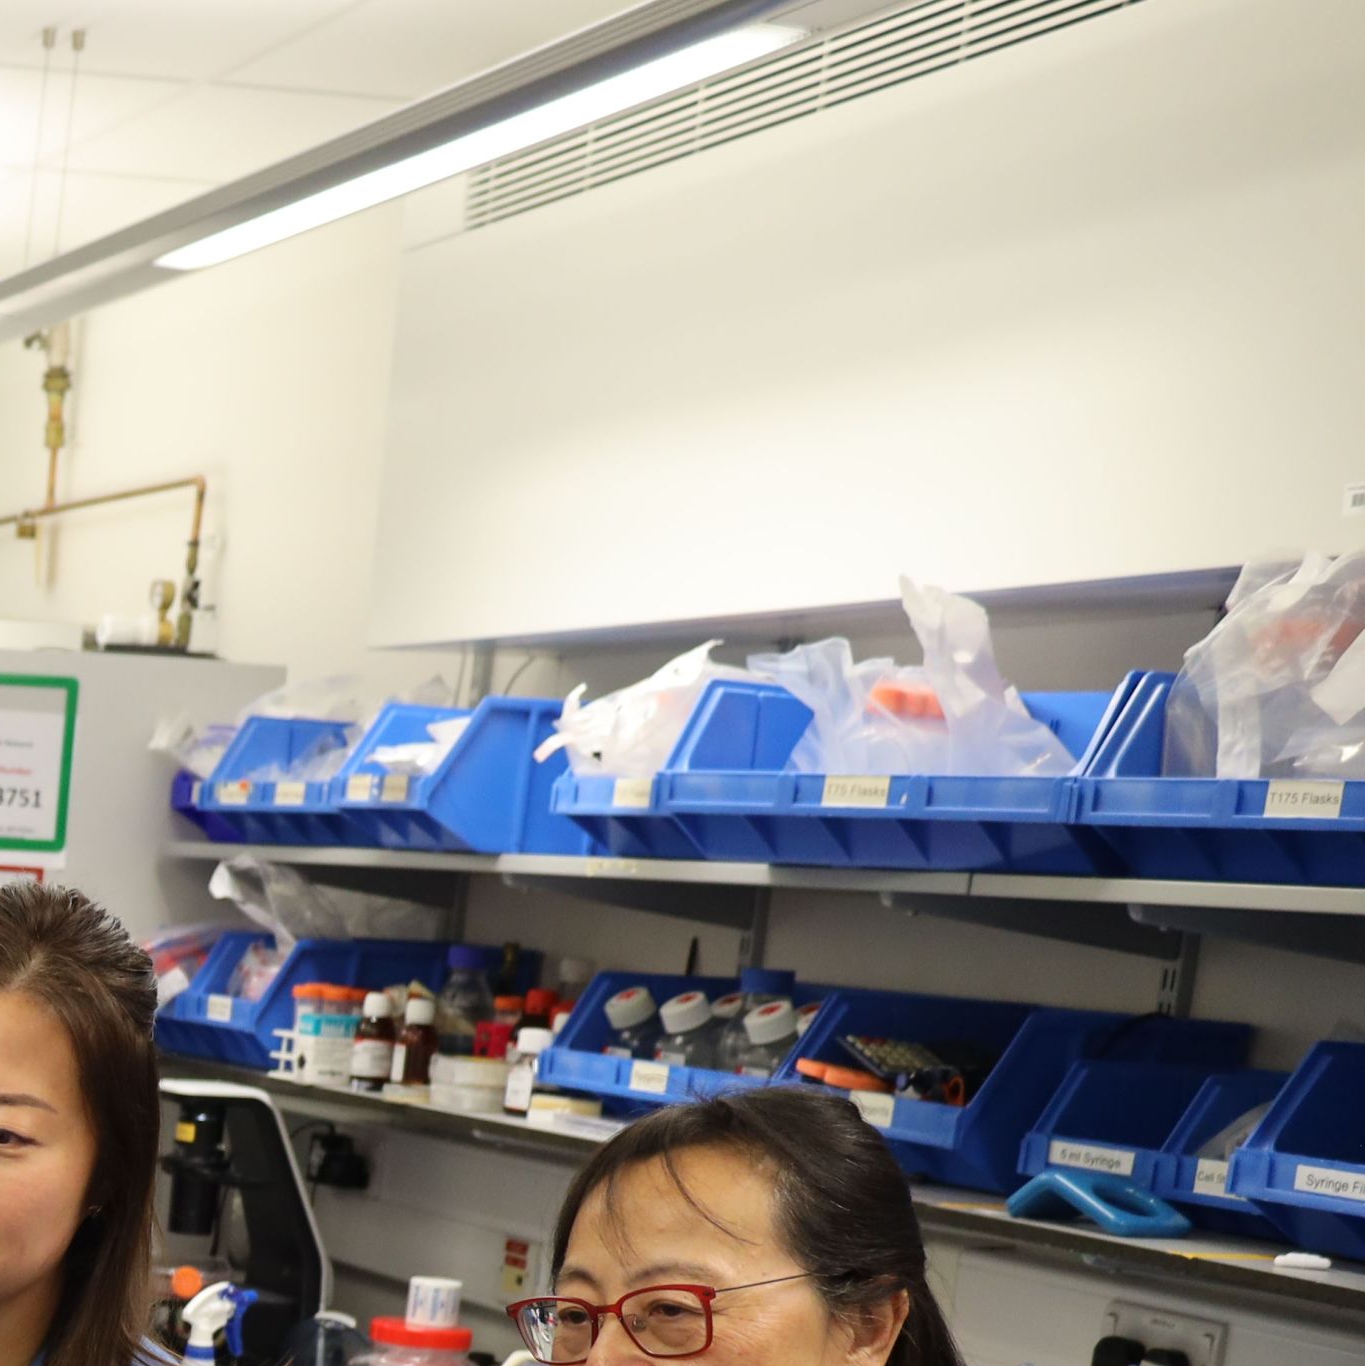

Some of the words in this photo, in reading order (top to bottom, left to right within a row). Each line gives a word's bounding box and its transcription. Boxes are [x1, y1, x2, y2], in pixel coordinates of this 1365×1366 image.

[1270, 792, 1299, 805] T175
[1301, 791, 1340, 805] Flasks
[1083, 1151, 1121, 1169] Syringe
[1305, 1173, 1349, 1193] Syringe
